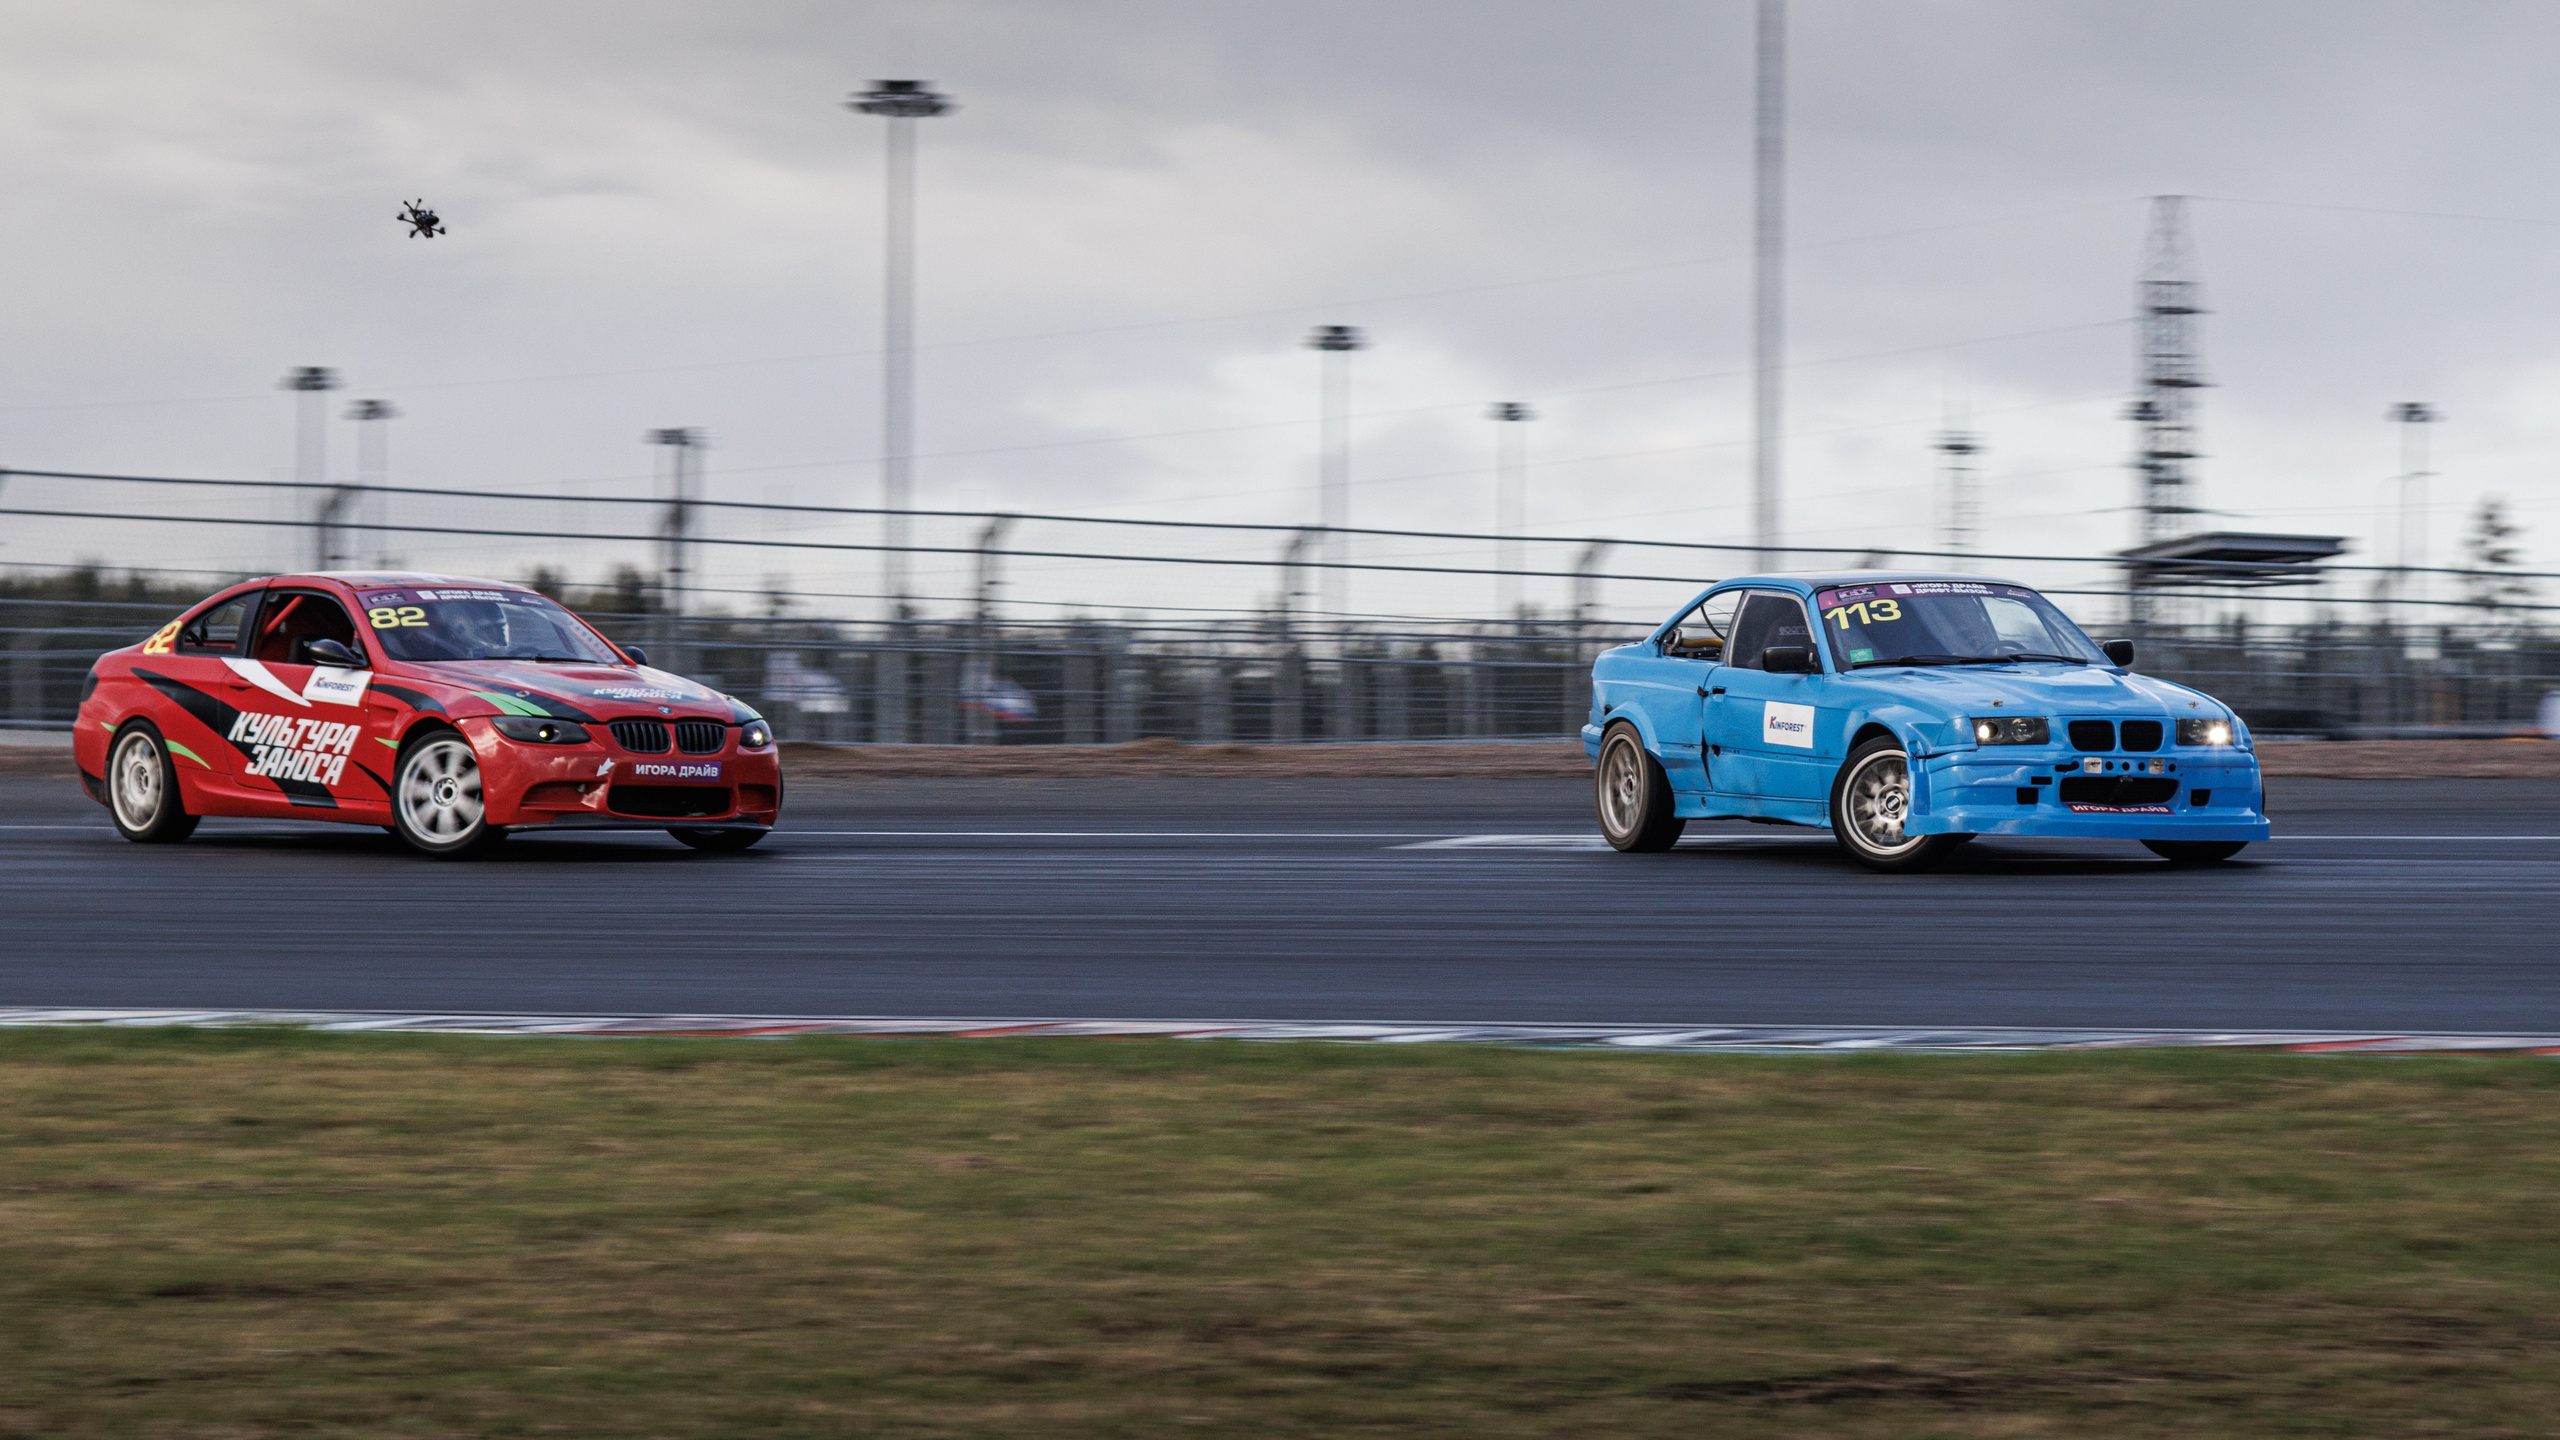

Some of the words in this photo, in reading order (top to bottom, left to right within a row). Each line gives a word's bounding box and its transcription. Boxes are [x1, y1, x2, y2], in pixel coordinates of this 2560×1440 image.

[368, 607, 429, 629] 82
[1825, 599, 1902, 630] 113
[143, 620, 183, 655] 82
[227, 711, 361, 755] КУЛЬТУРА
[244, 744, 347, 786] ЗАНОСА
[635, 764, 676, 776] ИГОРА
[678, 764, 719, 778] ДРАЙВ
[2120, 805, 2169, 813] ДРАЙВ
